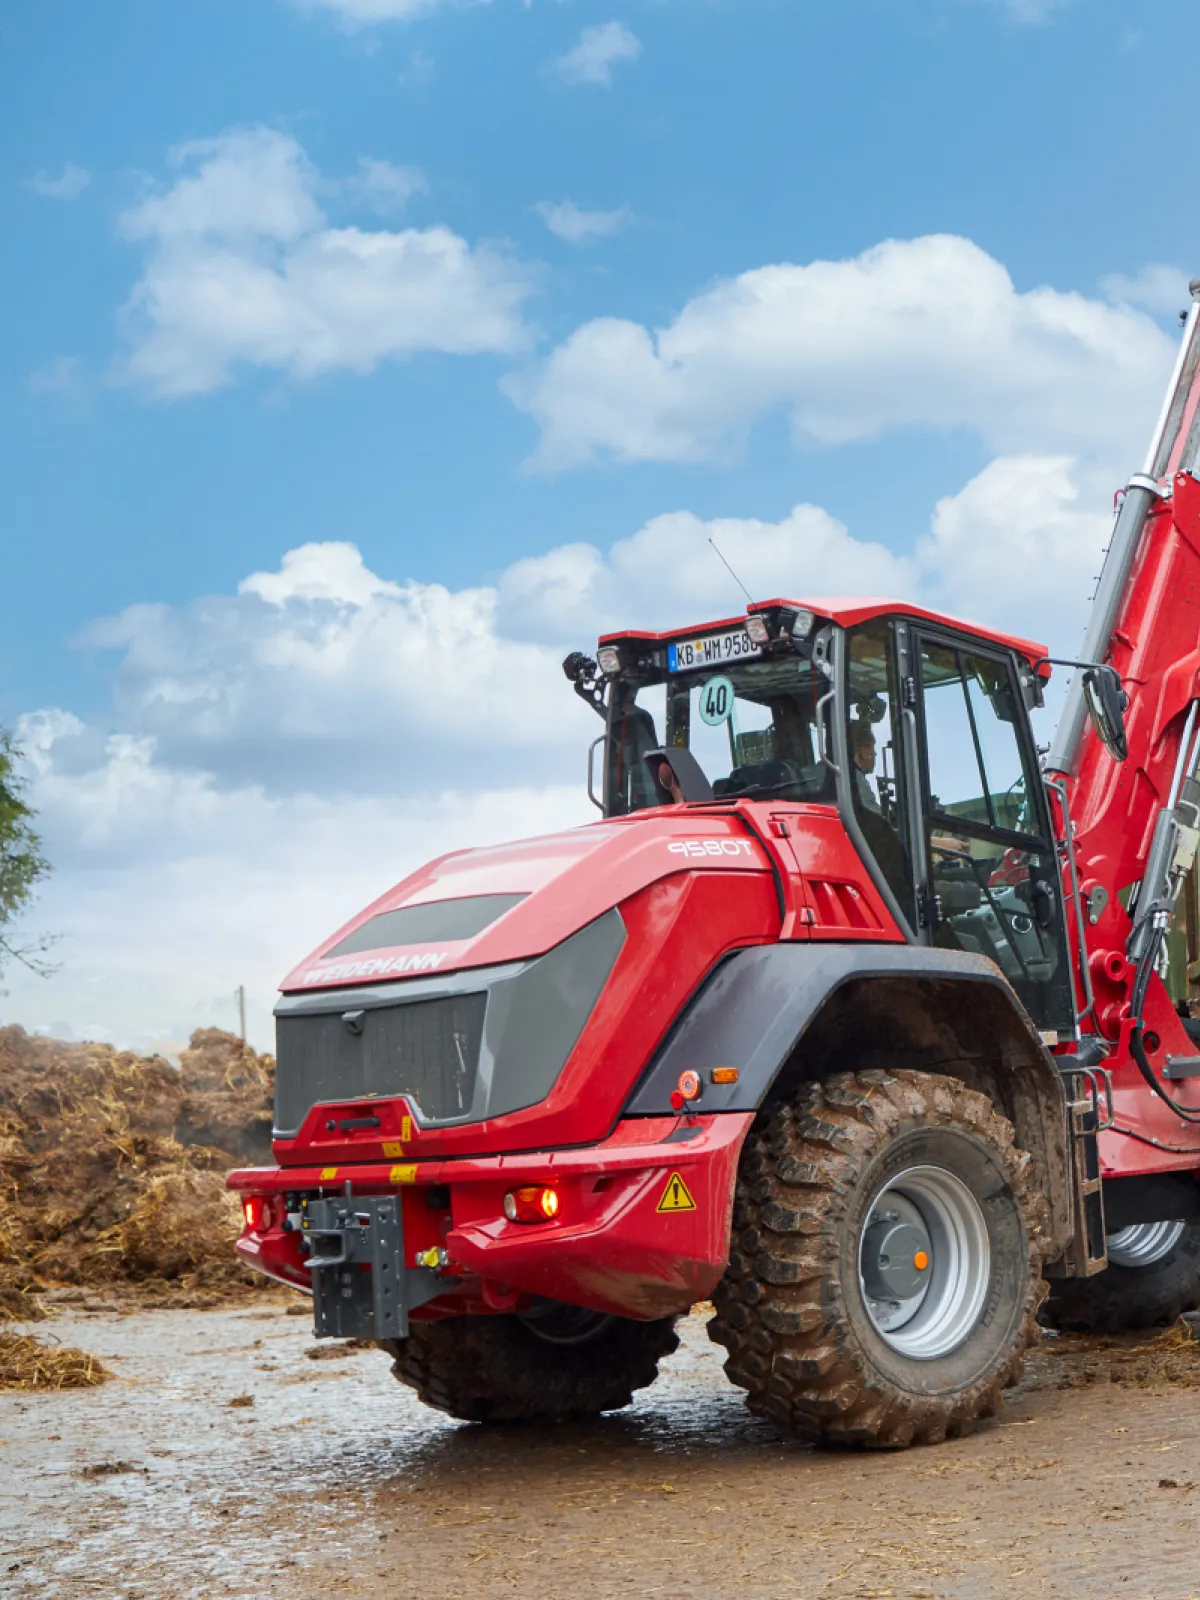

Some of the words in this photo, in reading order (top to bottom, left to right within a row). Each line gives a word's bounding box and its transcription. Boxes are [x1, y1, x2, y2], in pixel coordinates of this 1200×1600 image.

[677, 644, 694, 667] KB
[703, 637, 720, 661] WM
[705, 684, 726, 717] 40
[667, 839, 752, 857] 9580T
[303, 952, 448, 985] WEIDEMANN
